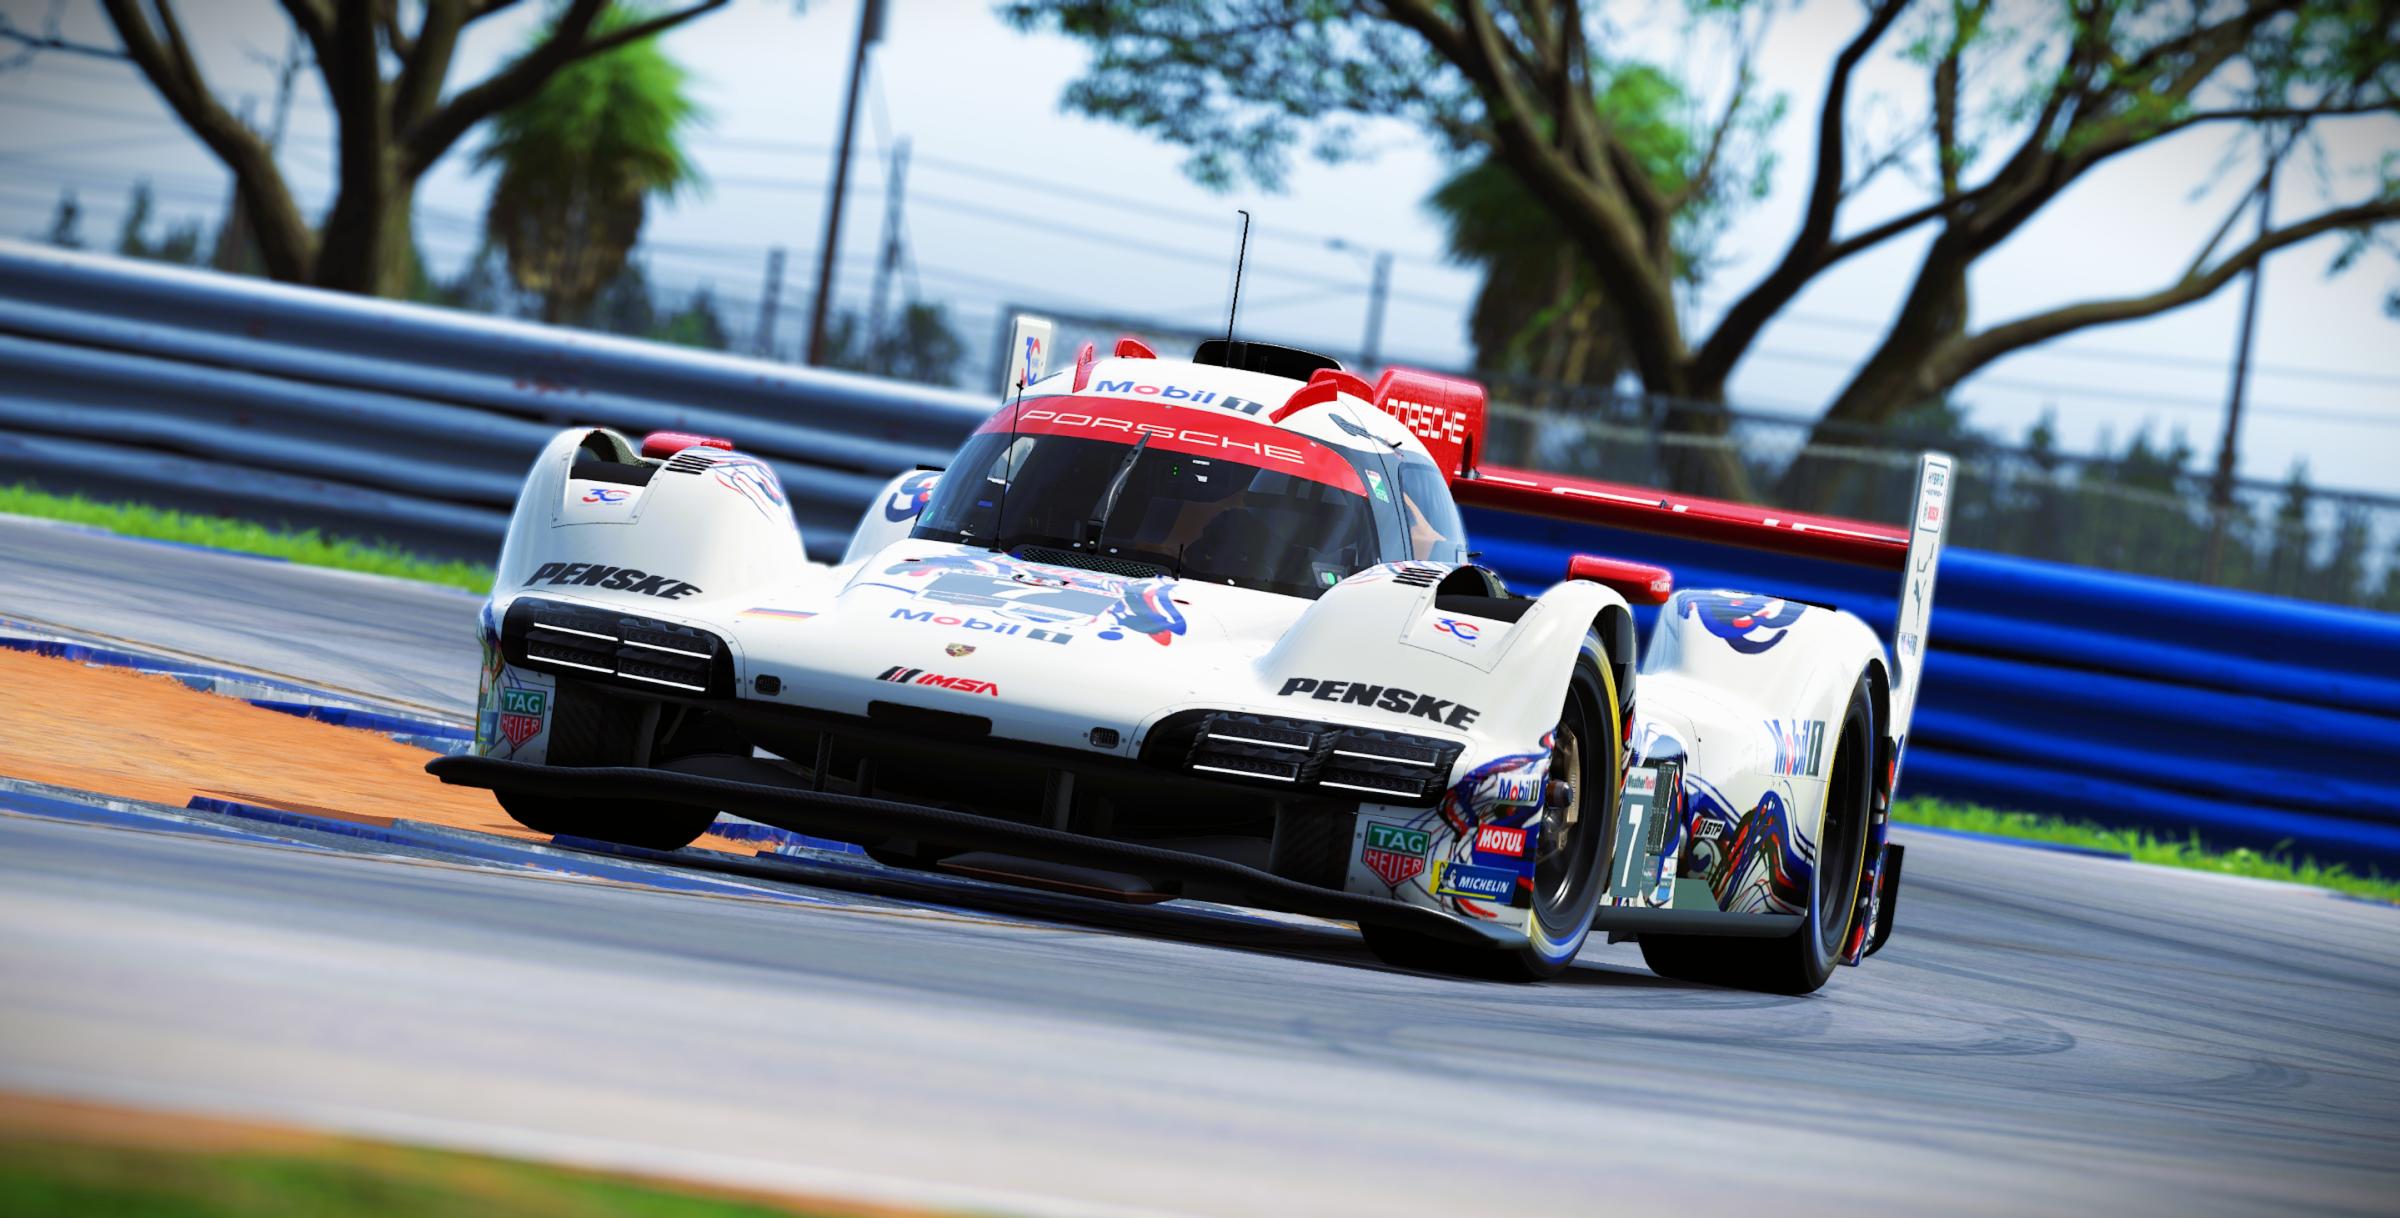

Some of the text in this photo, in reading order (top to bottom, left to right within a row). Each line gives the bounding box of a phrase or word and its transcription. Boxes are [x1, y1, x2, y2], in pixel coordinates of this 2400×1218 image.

[1095, 380, 1217, 404] Mobil
[1385, 398, 1467, 445] PORSCHE
[1019, 409, 1305, 465] PORSCHE
[522, 562, 703, 601] PENSKE
[889, 608, 1021, 636] Mobil
[915, 673, 999, 698] IMSA
[507, 691, 541, 713] TAG
[1277, 677, 1480, 732] PENSKE
[502, 712, 540, 742] HEUER
[1763, 719, 1810, 777] Mobil
[1499, 777, 1530, 801] Mobil
[1374, 828, 1424, 852] TAG
[1478, 828, 1523, 853] MOTUL
[1620, 804, 1644, 888] 7
[1367, 850, 1421, 883] HEUER
[1458, 875, 1509, 894] MICHELIN
